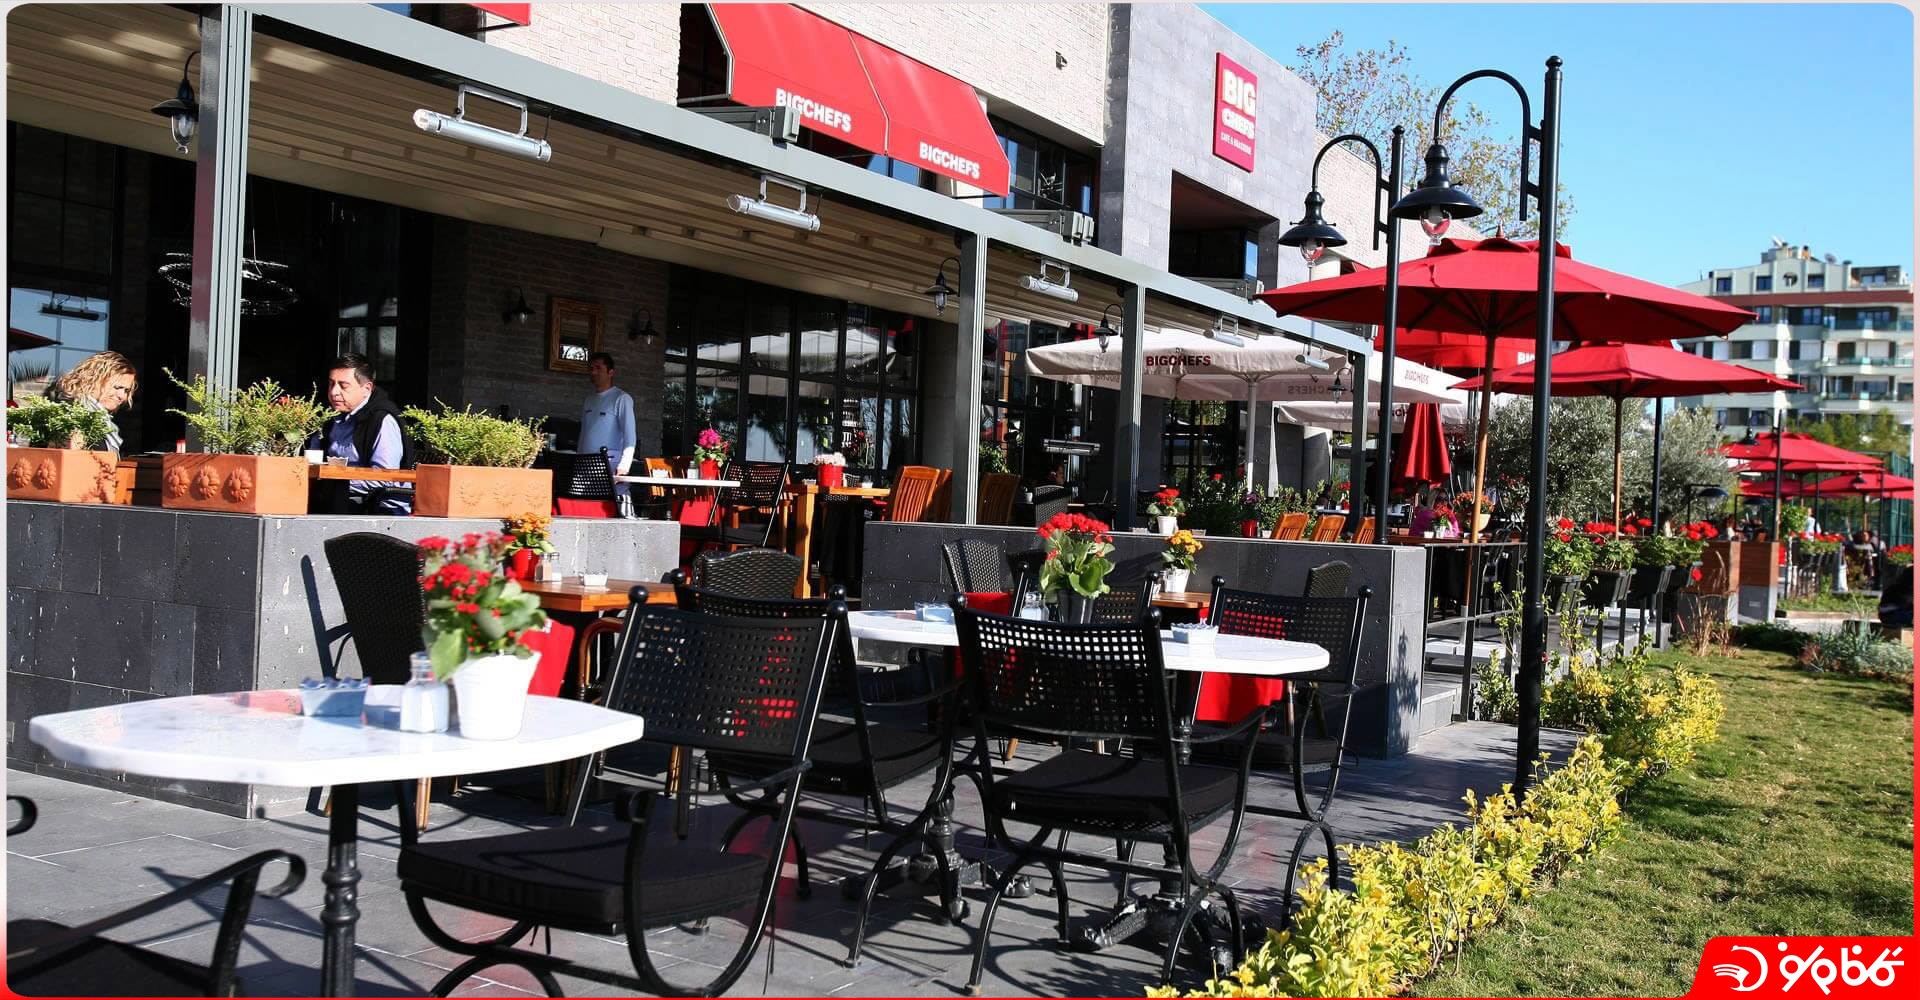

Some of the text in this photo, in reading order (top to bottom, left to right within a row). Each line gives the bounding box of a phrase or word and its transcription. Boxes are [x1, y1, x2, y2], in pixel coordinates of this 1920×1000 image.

[776, 88, 851, 133] BIGCHEFS
[1222, 69, 1256, 117] BIG
[919, 142, 981, 179] BIGCHEFS
[1146, 355, 1211, 367] BIGCHEFS
